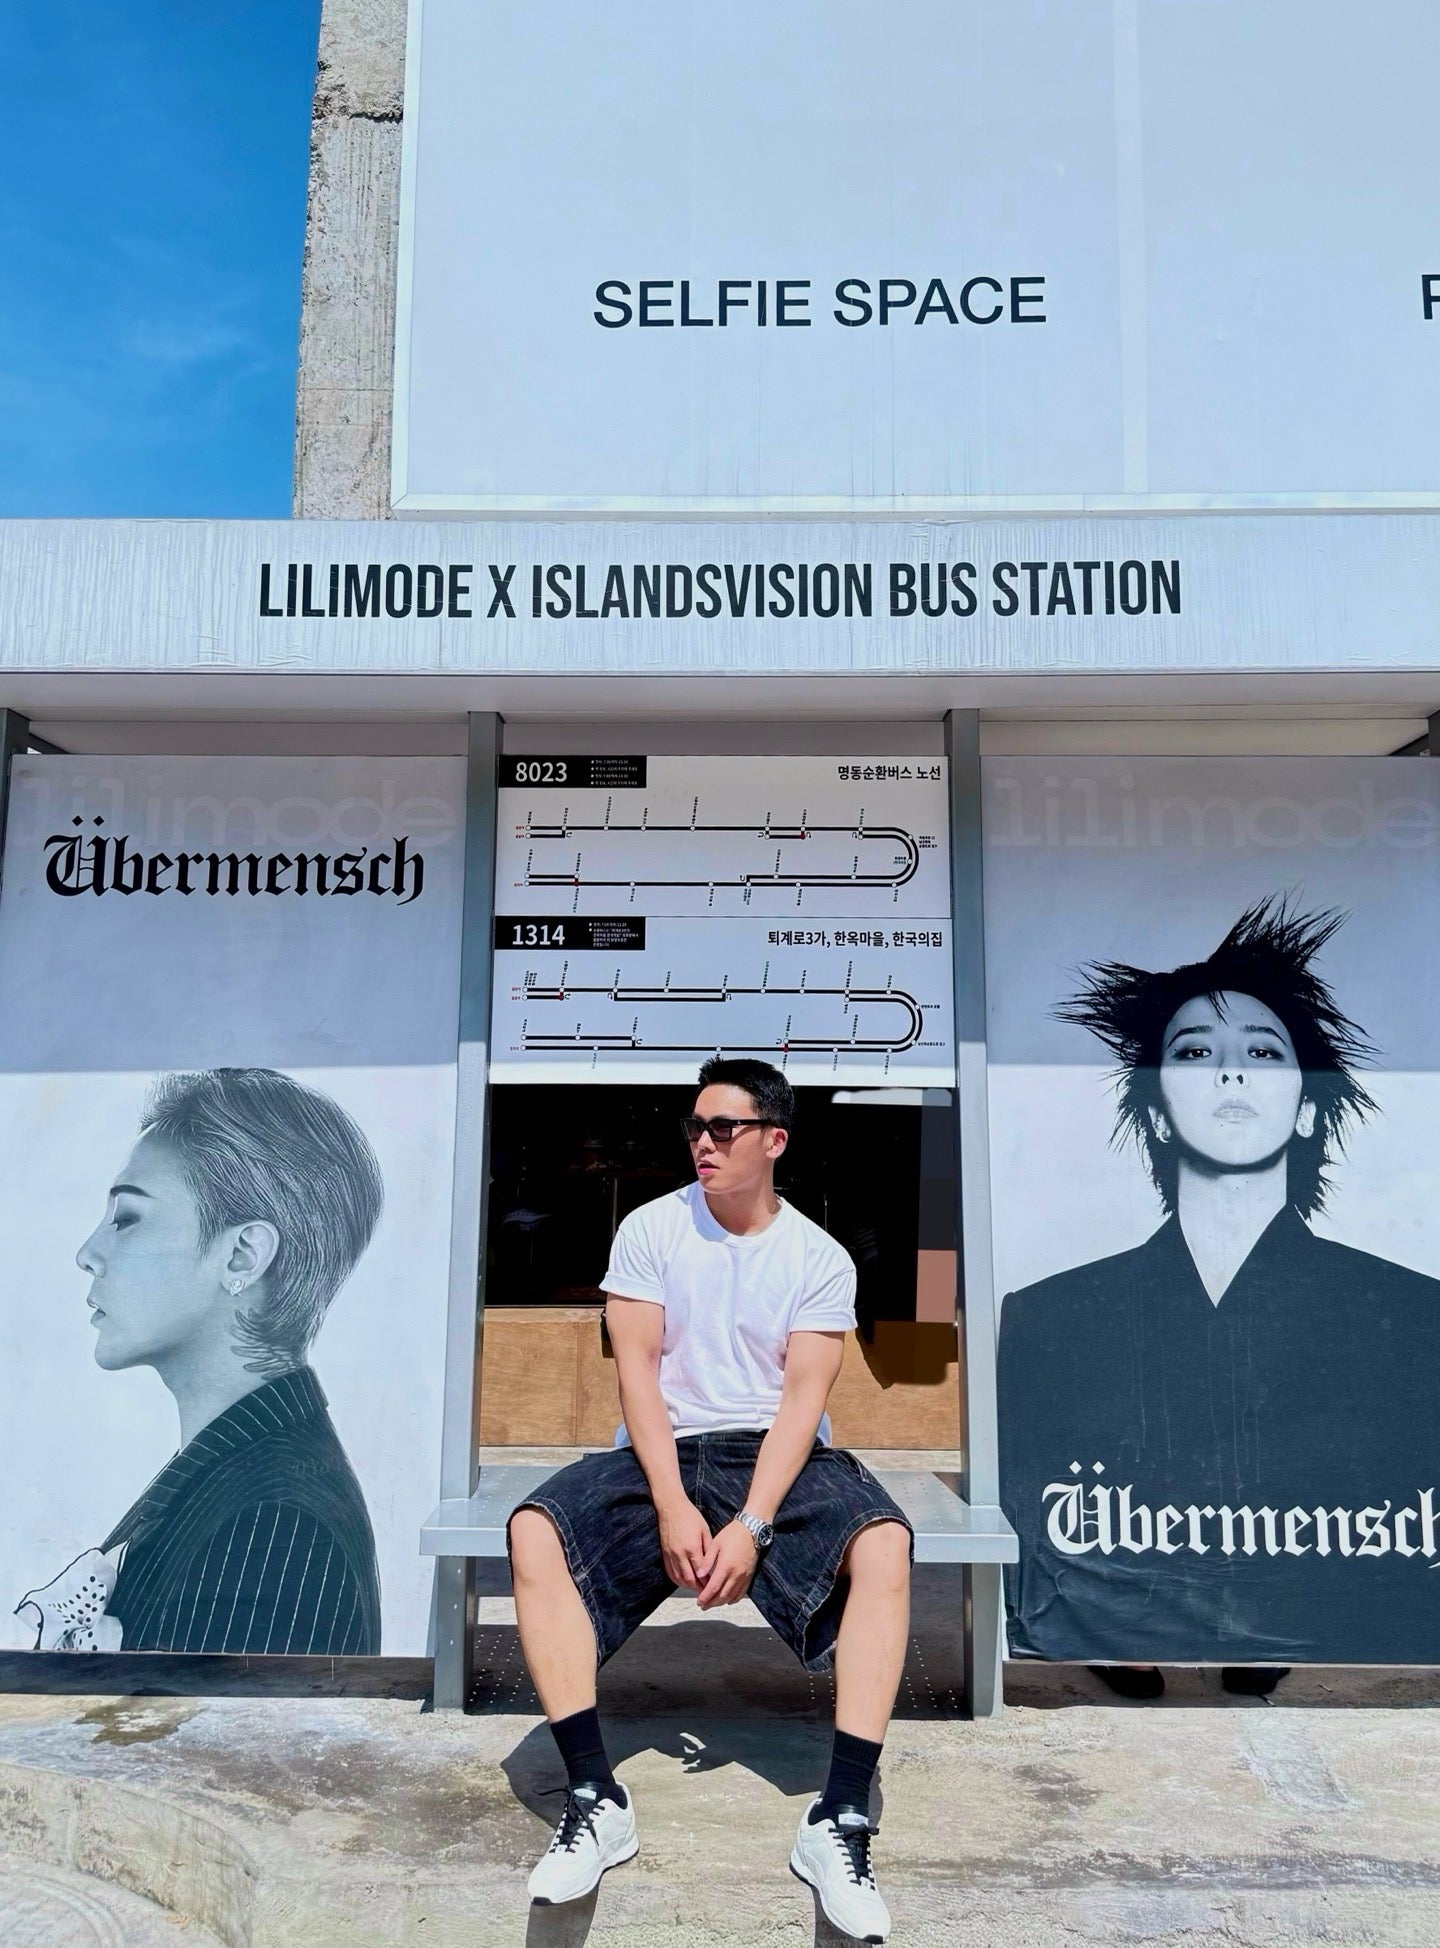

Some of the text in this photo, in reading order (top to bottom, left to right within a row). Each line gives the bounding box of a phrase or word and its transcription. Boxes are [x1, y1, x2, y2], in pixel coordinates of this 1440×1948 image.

[594, 276, 1047, 329] SELFIE SPACE
[259, 560, 1181, 619] LILIMODE X ISLANDSVISION BUS STATION
[515, 762, 568, 783] 8023
[837, 765, 942, 781] 명동순환버스 노선
[43, 815, 424, 906] Übermensch
[512, 924, 566, 946] 1314
[767, 930, 943, 949] 퇴계로3가, 한옥마을, 한국의집
[1042, 1460, 1440, 1569] Übermensch
